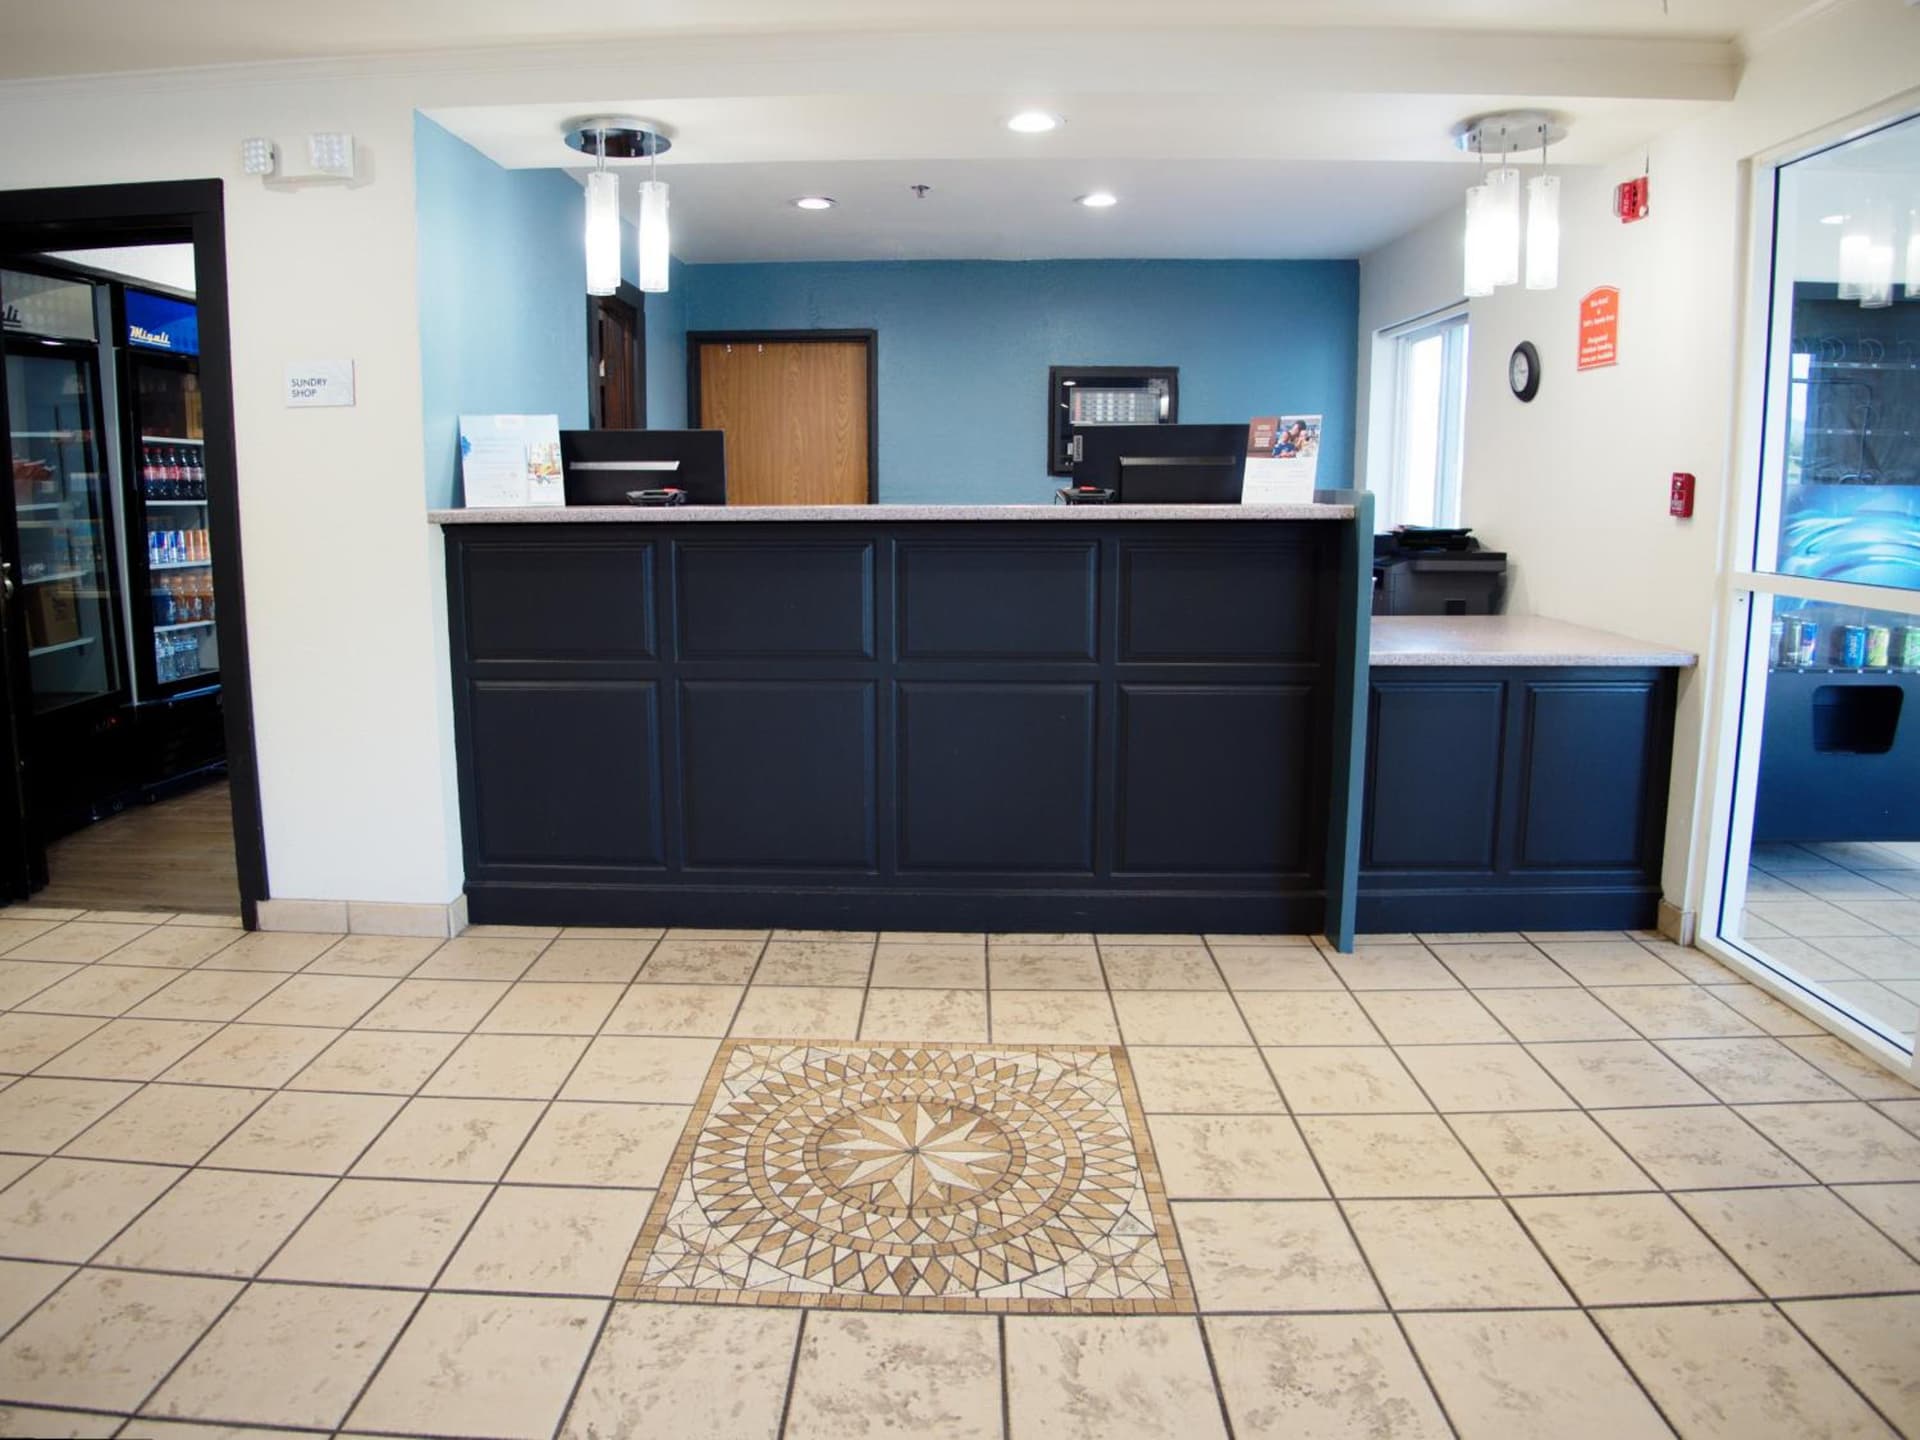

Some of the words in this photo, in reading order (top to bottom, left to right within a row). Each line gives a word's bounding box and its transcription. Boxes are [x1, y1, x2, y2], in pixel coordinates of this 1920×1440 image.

[129, 325, 171, 344] Migali
[291, 378, 327, 387] SUNDRY
[291, 388, 317, 398] SHOP
